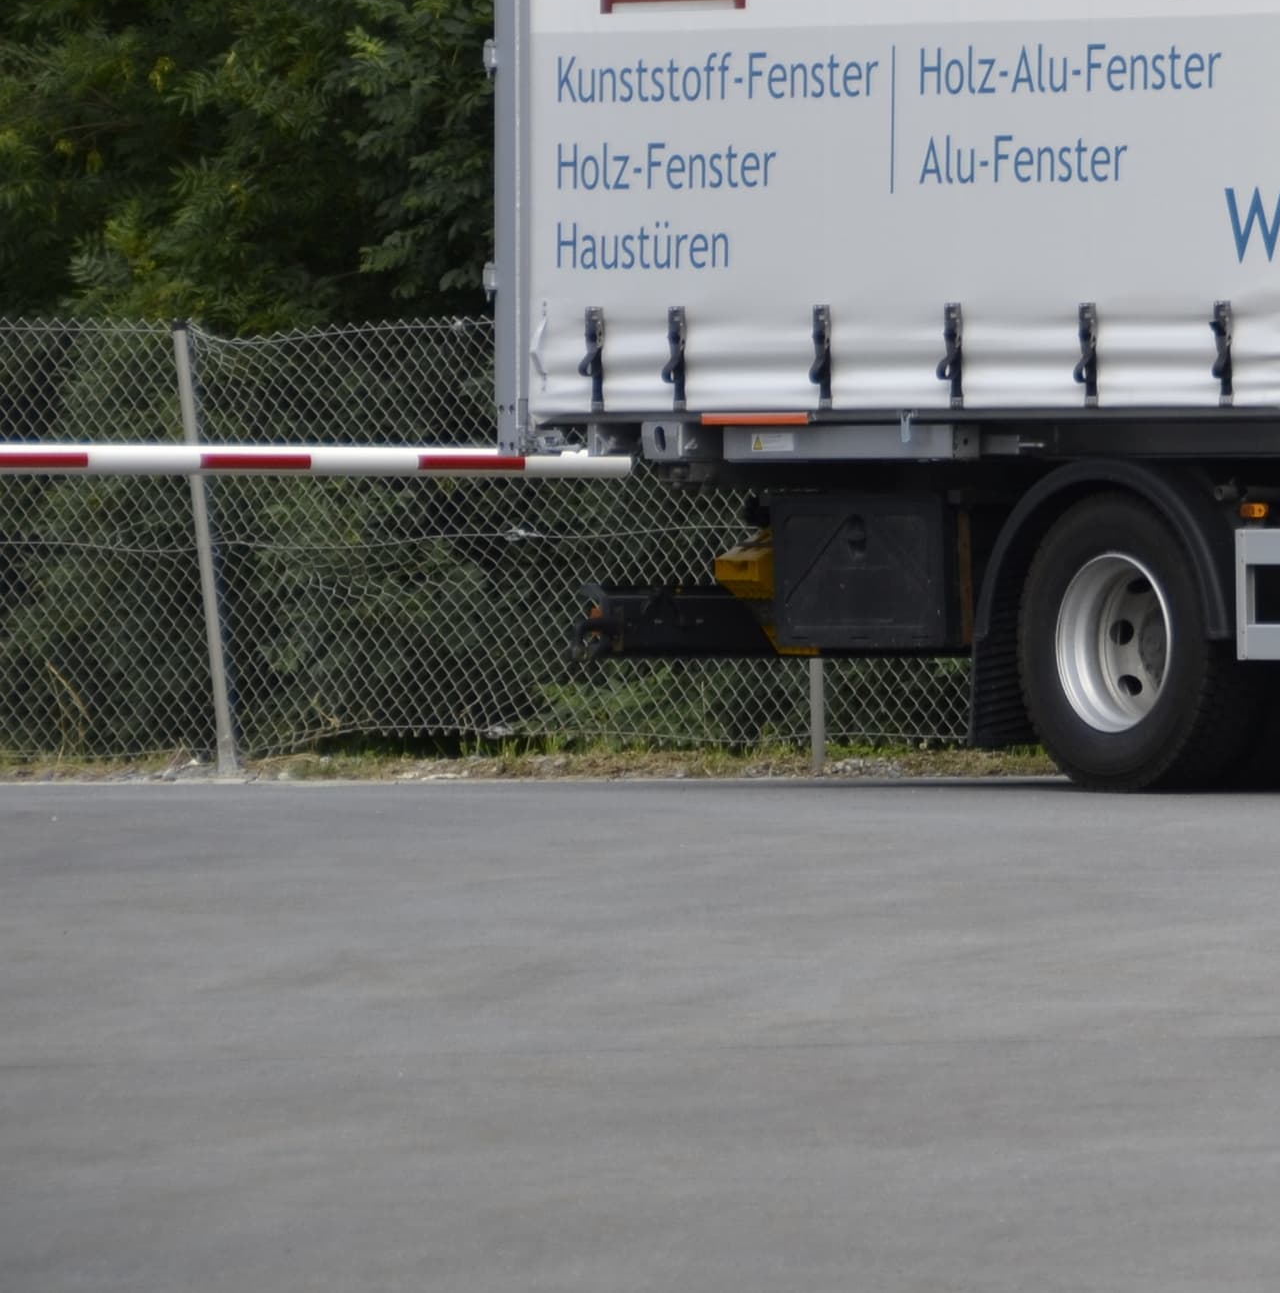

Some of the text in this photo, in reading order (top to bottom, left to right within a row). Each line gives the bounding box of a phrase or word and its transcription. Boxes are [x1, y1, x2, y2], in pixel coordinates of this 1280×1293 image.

[556, 51, 880, 103] Kunststoff-Fenster
[919, 43, 1222, 95] Holz-Alu-Fenster
[556, 141, 777, 191] Holz-Fenster
[919, 133, 1128, 184] Alu-Fenster
[556, 223, 730, 270] Haustüren
